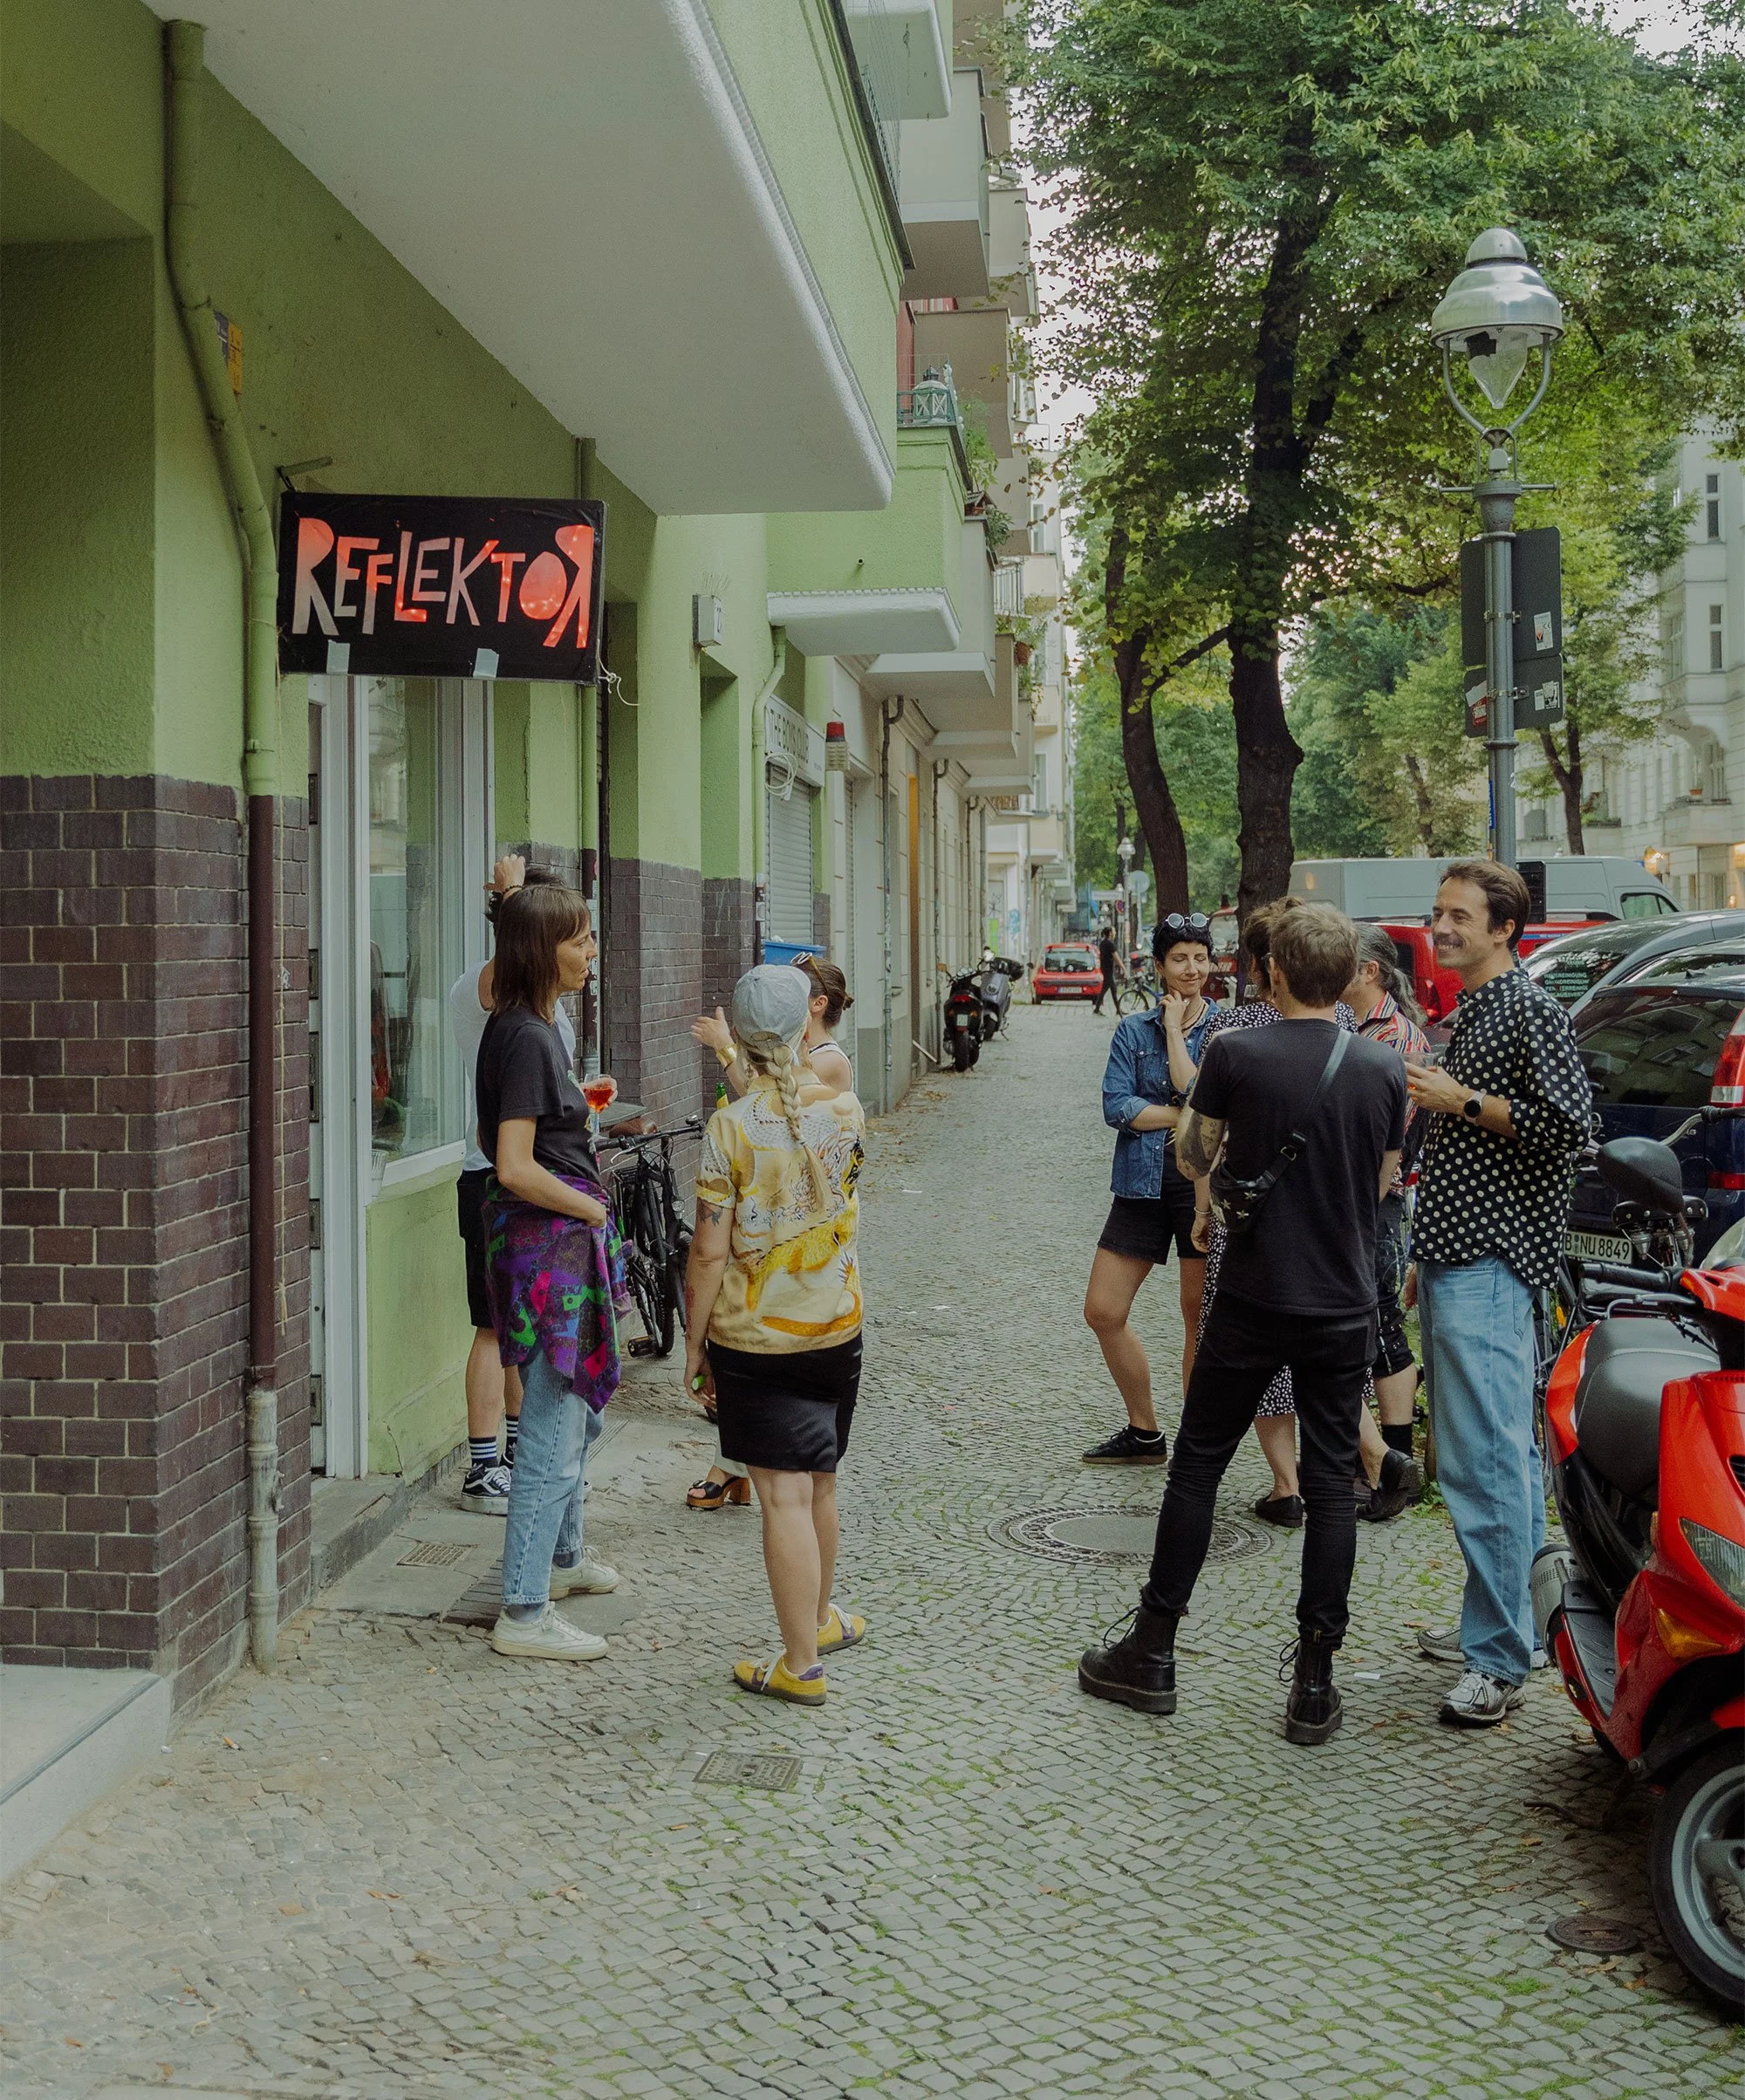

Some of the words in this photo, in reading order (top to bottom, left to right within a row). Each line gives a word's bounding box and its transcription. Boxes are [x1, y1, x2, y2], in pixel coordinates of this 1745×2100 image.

[770, 708, 782, 747] THE
[1564, 1234, 1572, 1251] B
[1580, 1235, 1596, 1255] NU
[1598, 1238, 1630, 1260] 8849
